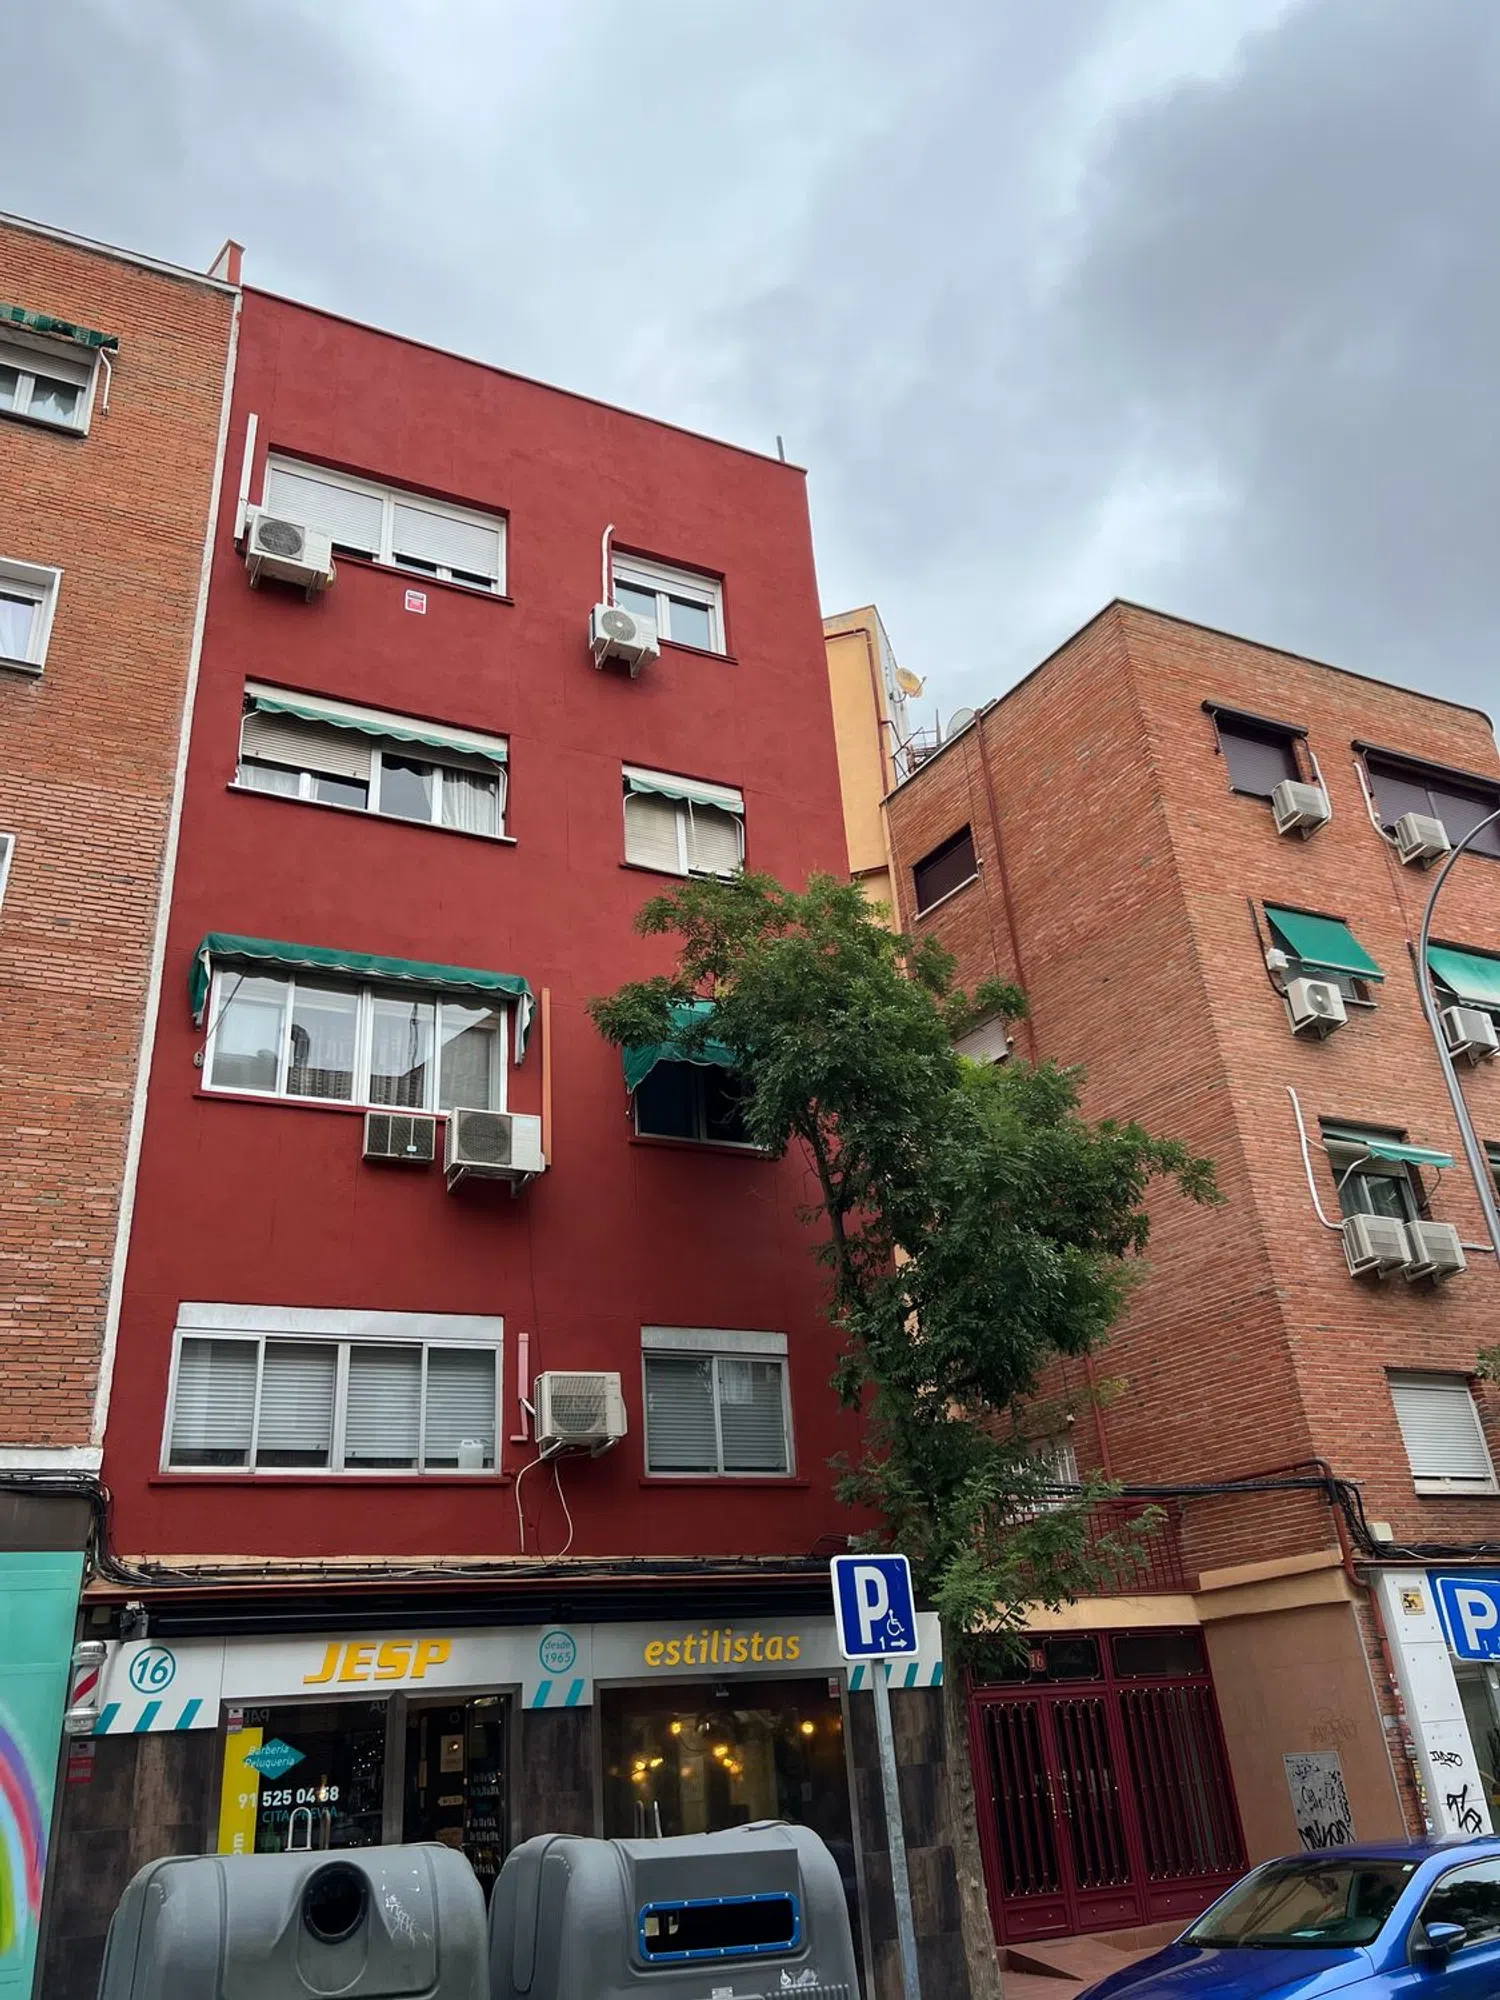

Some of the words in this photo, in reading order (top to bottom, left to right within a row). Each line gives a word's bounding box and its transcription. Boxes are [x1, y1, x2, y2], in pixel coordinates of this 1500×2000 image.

[854, 1566, 889, 1645] P
[1454, 1588, 1498, 1651] P
[545, 1640, 571, 1650] desde
[644, 1627, 801, 1666] estilistas
[879, 1636, 886, 1650] 1
[137, 1655, 169, 1684] 16
[303, 1638, 453, 1684] JESP
[545, 1651, 571, 1664] 1965
[238, 1793, 258, 1809] 91
[262, 1789, 292, 1807] 525
[296, 1787, 316, 1803] 04
[262, 1810, 290, 1823] CITA
